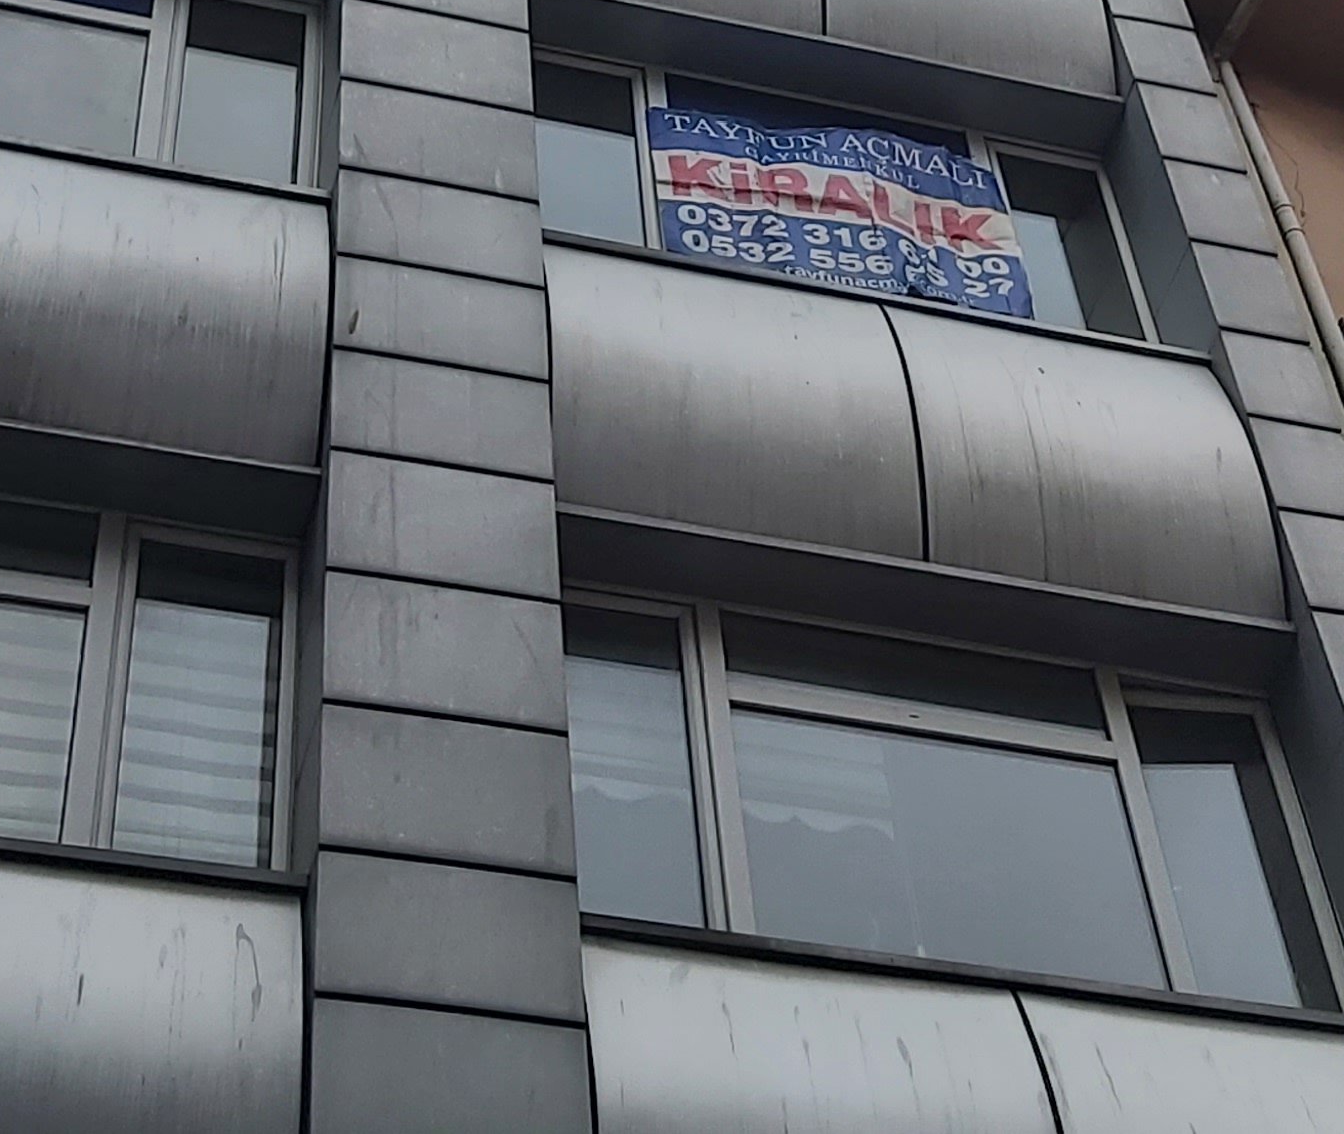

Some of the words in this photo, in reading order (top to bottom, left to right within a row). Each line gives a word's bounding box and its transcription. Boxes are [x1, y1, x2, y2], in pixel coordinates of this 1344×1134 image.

[664, 113, 829, 150] TAYFUN
[840, 133, 988, 190] AÇMALI
[677, 204, 790, 239] 0372
[802, 222, 887, 251] 316
[681, 229, 796, 264] 0532
[809, 247, 895, 276] 556
[962, 277, 1015, 298] 27
